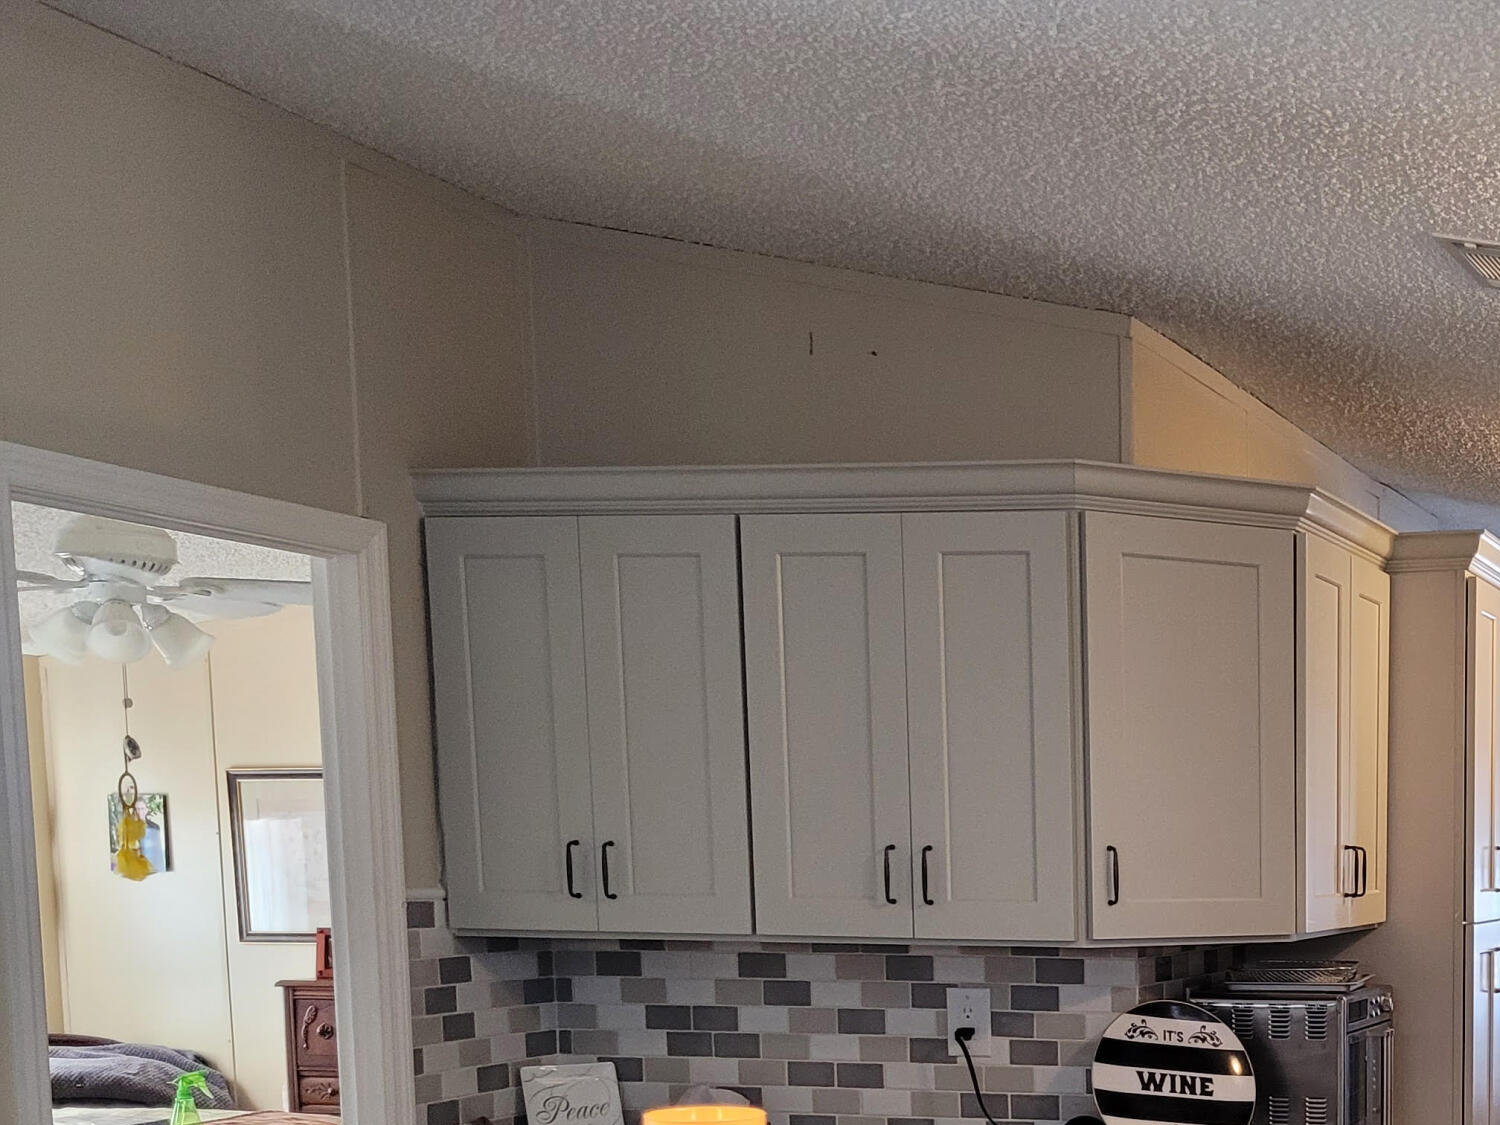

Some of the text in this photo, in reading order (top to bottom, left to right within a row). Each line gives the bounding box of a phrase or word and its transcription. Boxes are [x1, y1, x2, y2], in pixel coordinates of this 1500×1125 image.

[1162, 1029, 1184, 1044] IT'S
[1136, 1070, 1215, 1098] WINE
[535, 1095, 611, 1125] Peace
